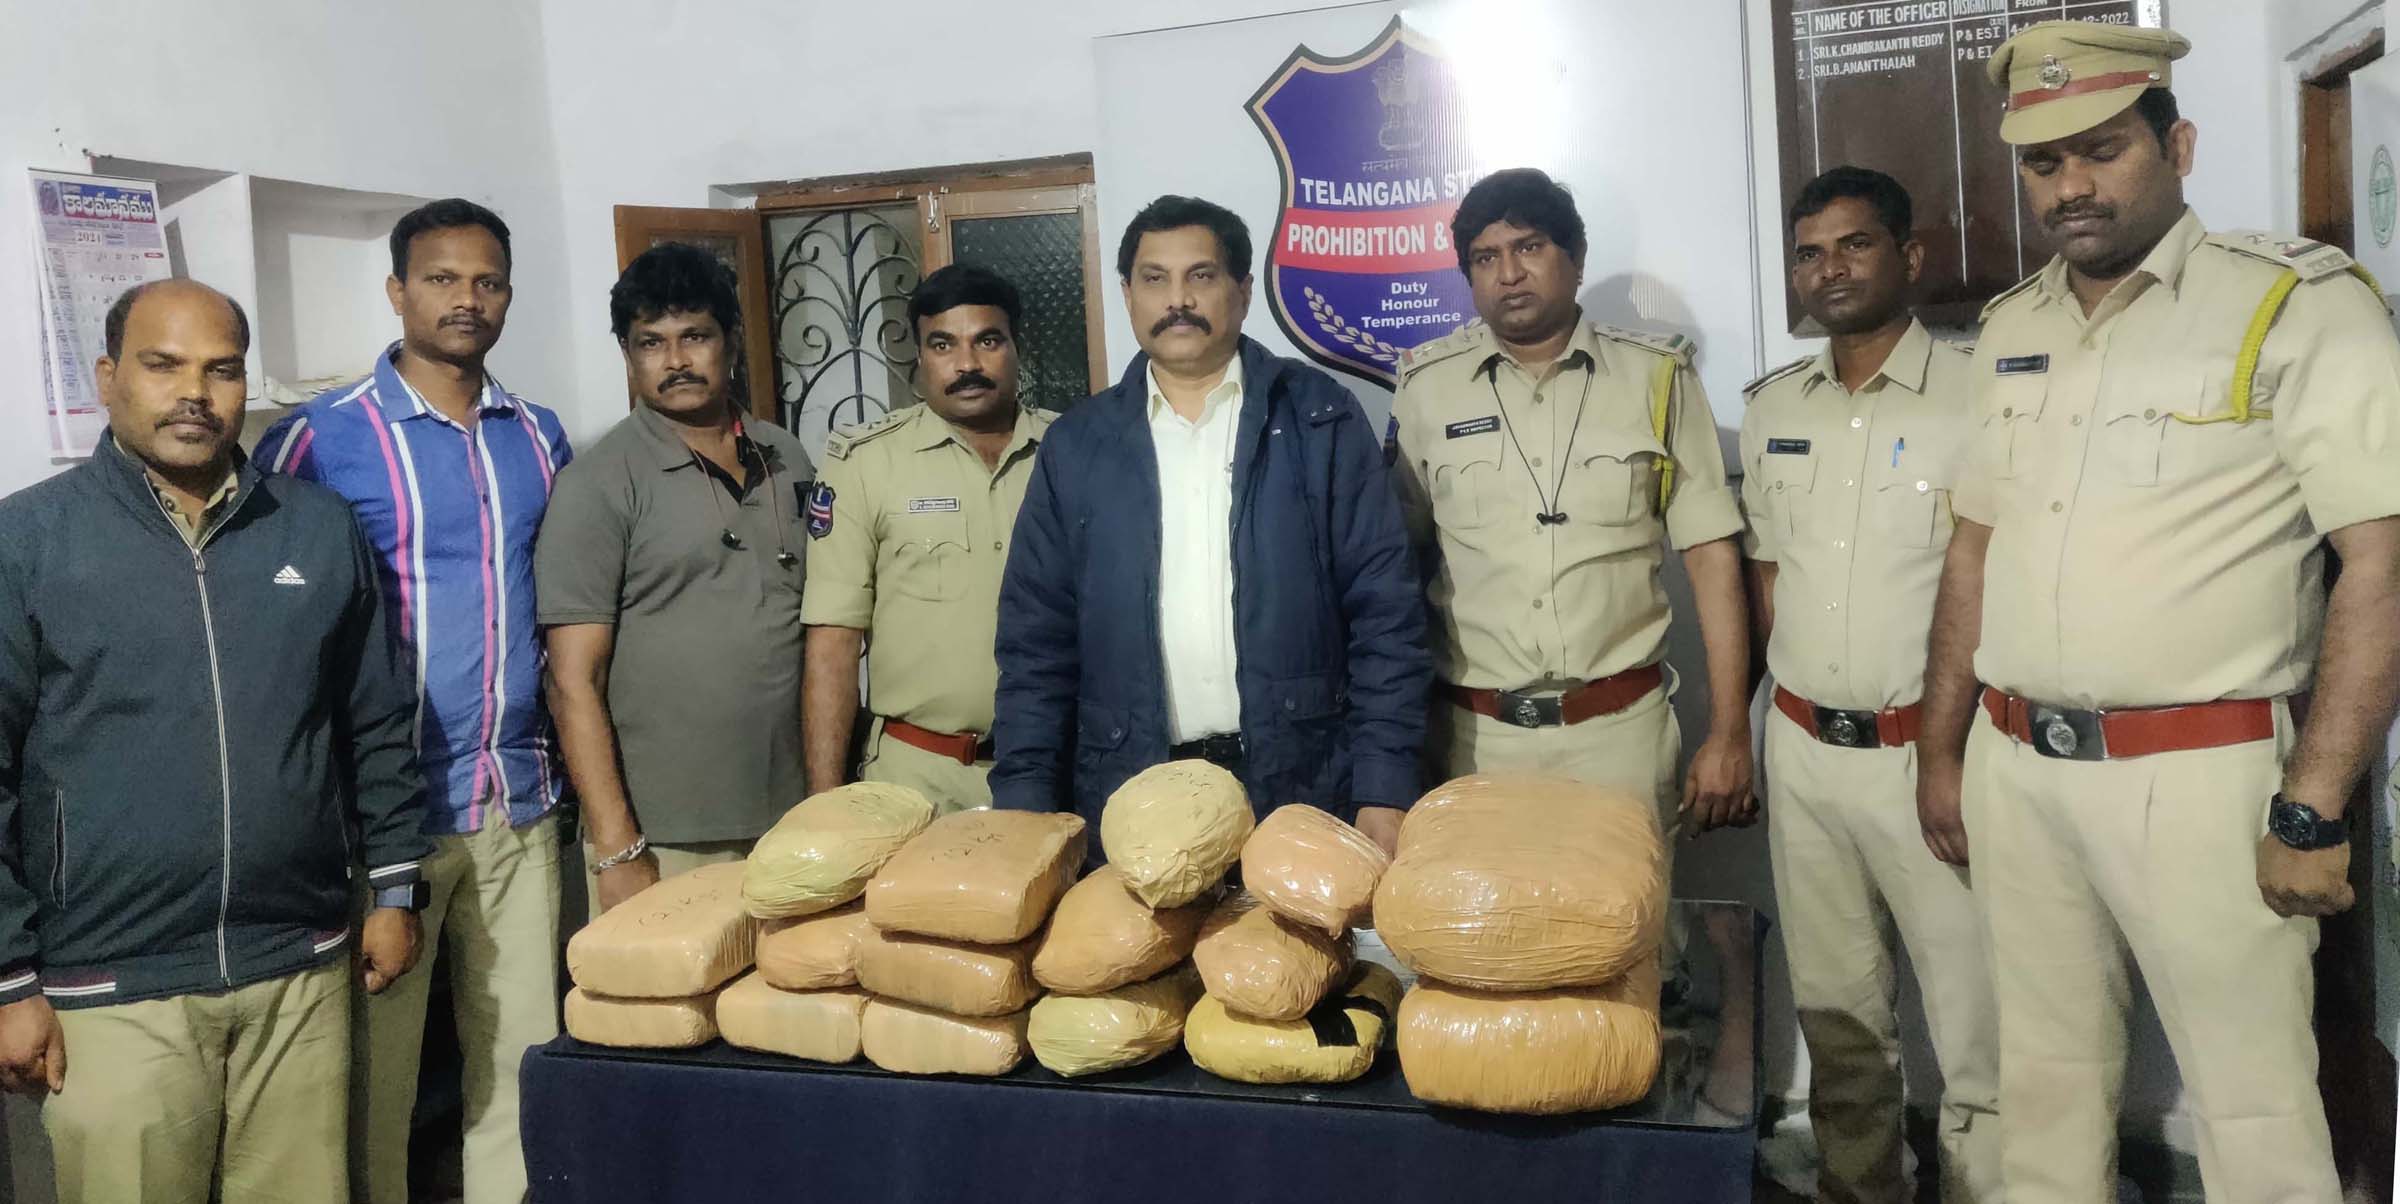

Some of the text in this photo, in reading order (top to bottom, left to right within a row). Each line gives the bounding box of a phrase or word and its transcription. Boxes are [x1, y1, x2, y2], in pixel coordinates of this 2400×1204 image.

[1815, 1, 1947, 32] NAME OF THE OFFICER
[1912, 32, 1944, 49] REDDY
[1956, 26, 2001, 42] P & ESI
[1958, 45, 1993, 61] P & EI
[1300, 177, 1437, 206] TELANGANA
[1287, 221, 1449, 256] PROHIBITION &
[1391, 281, 1428, 296] Duty
[1381, 297, 1441, 312] Honour
[1361, 311, 1462, 329] Temperance
[274, 577, 305, 585] adidas
